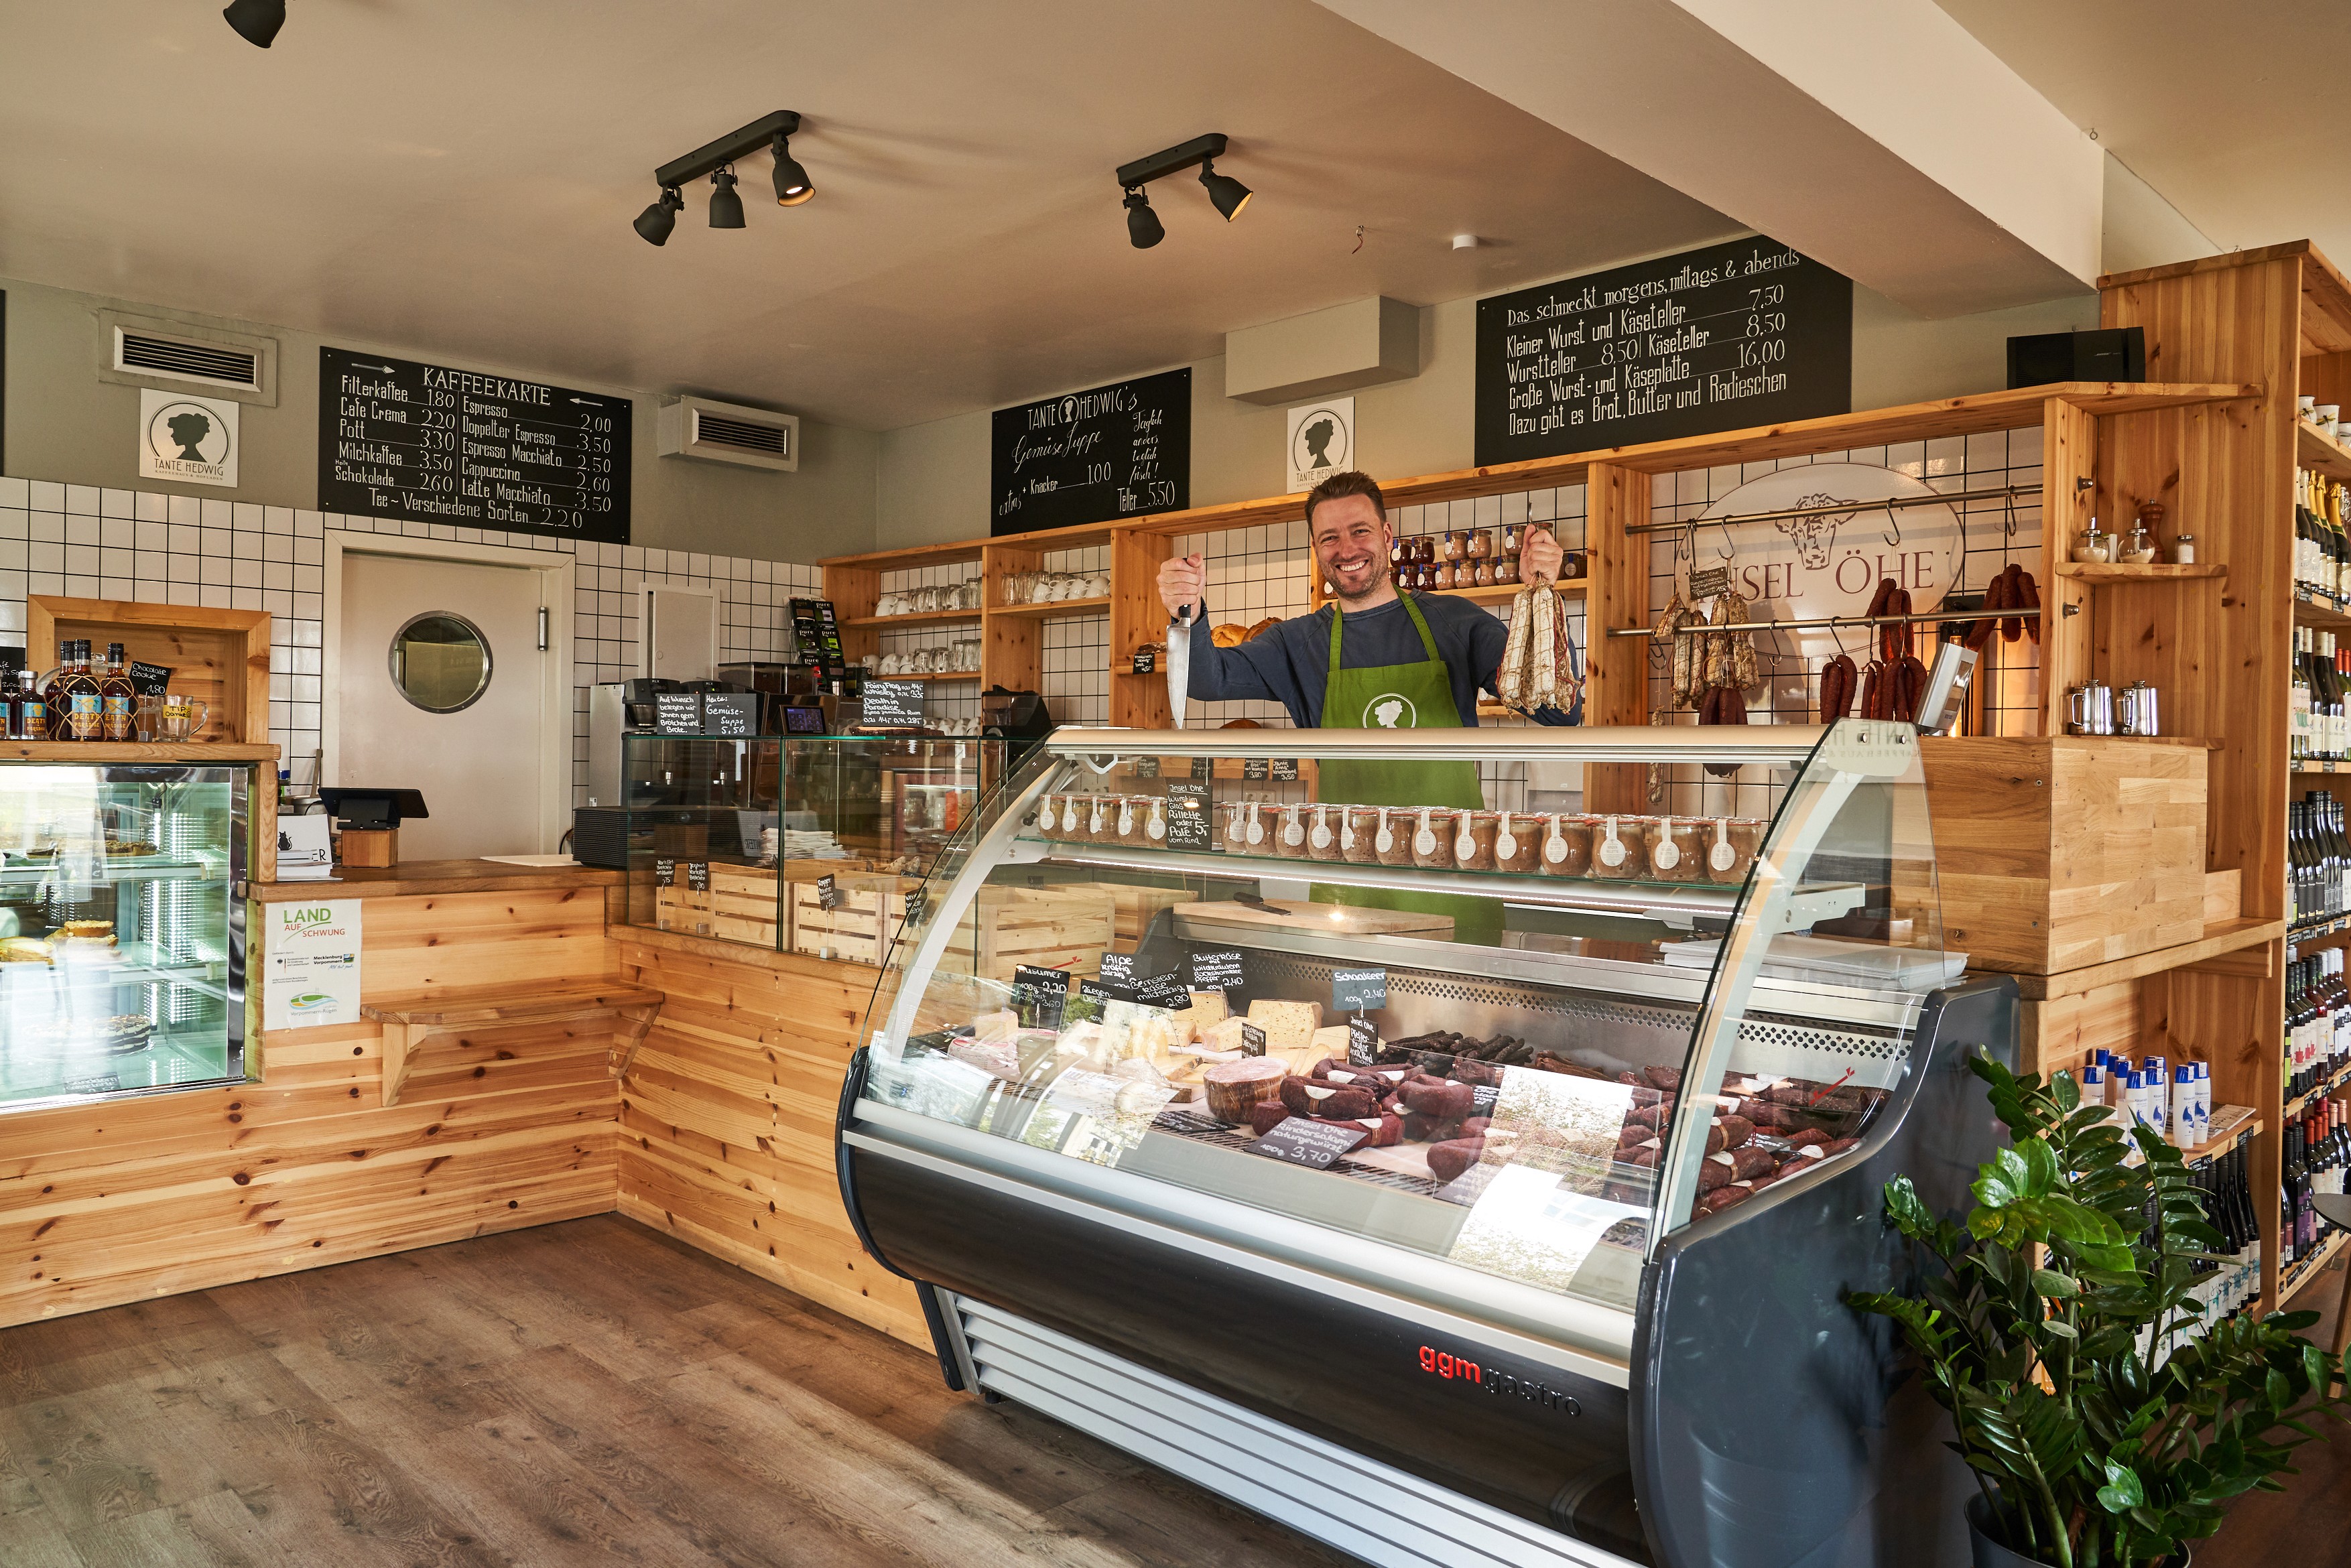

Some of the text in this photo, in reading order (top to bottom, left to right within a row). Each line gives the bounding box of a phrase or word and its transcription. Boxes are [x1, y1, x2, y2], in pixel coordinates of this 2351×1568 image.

[1508, 249, 1799, 325] Das schmeckt morgens, mittags & abends
[1507, 299, 1686, 358] Kleiner Wurst und Käseteller
[1507, 350, 1576, 384] Wurstteller
[1649, 325, 1710, 356] Käseteller
[342, 375, 408, 402] Filterkaffee
[424, 367, 551, 405] KAFFEEKARTE
[1509, 383, 1542, 409] Große
[1596, 367, 1616, 395] und
[1625, 354, 1690, 390] Käseplatte
[464, 396, 508, 418] Espresso
[1509, 413, 1536, 436] Dazu
[1541, 404, 1564, 435] gibt
[1571, 409, 1584, 425] es
[1628, 386, 1671, 416] Butter
[1677, 379, 1701, 409] und
[1710, 366, 1786, 402] Radieschen
[371, 401, 407, 423] Crema
[1028, 403, 1056, 430] TANTE
[340, 418, 365, 439] Pott
[463, 415, 556, 446] Doppelter Espresso
[339, 441, 402, 466] Milchkaffee
[462, 437, 562, 467] Espresso Macchiato
[154, 458, 223, 476] TANTE HEDWIG
[336, 465, 394, 486] Schokolade
[462, 456, 520, 481] Cappuccino
[1296, 471, 1314, 482] TANTE
[462, 478, 550, 505] Latte Macchiato
[1031, 476, 1058, 495] Knacker
[369, 488, 388, 507] Tee
[402, 491, 481, 517] Verschiedene
[488, 500, 529, 523] Sorten
[1117, 487, 1137, 512] Teller
[1835, 549, 1934, 594] ÖHE
[132, 670, 157, 680] Cookie
[133, 663, 166, 675] Chocolate
[147, 684, 166, 694] 1,80
[864, 682, 901, 691] Fairy Flag
[864, 689, 896, 698] Whisky
[706, 695, 728, 703] Heute:
[720, 716, 744, 726] Suppe
[1168, 810, 1202, 820] Rillette
[284, 908, 331, 923] LAND
[302, 928, 345, 937] SCHWUNG
[1106, 954, 1134, 965] Alpe
[1192, 952, 1243, 962] Butterkäse
[1100, 970, 1125, 980] würzig
[1101, 964, 1131, 974] kräftig
[1334, 972, 1386, 982] Schaalseer
[1020, 982, 1039, 994] 100g
[1129, 973, 1178, 990] Bernstein-
[1142, 982, 1167, 993] käse
[1345, 996, 1362, 1004] 100g
[1269, 1129, 1342, 1155] naturgewürzt
[1276, 1122, 1352, 1147] Rindersalami
[1419, 1346, 1582, 1417] ggm gastro
